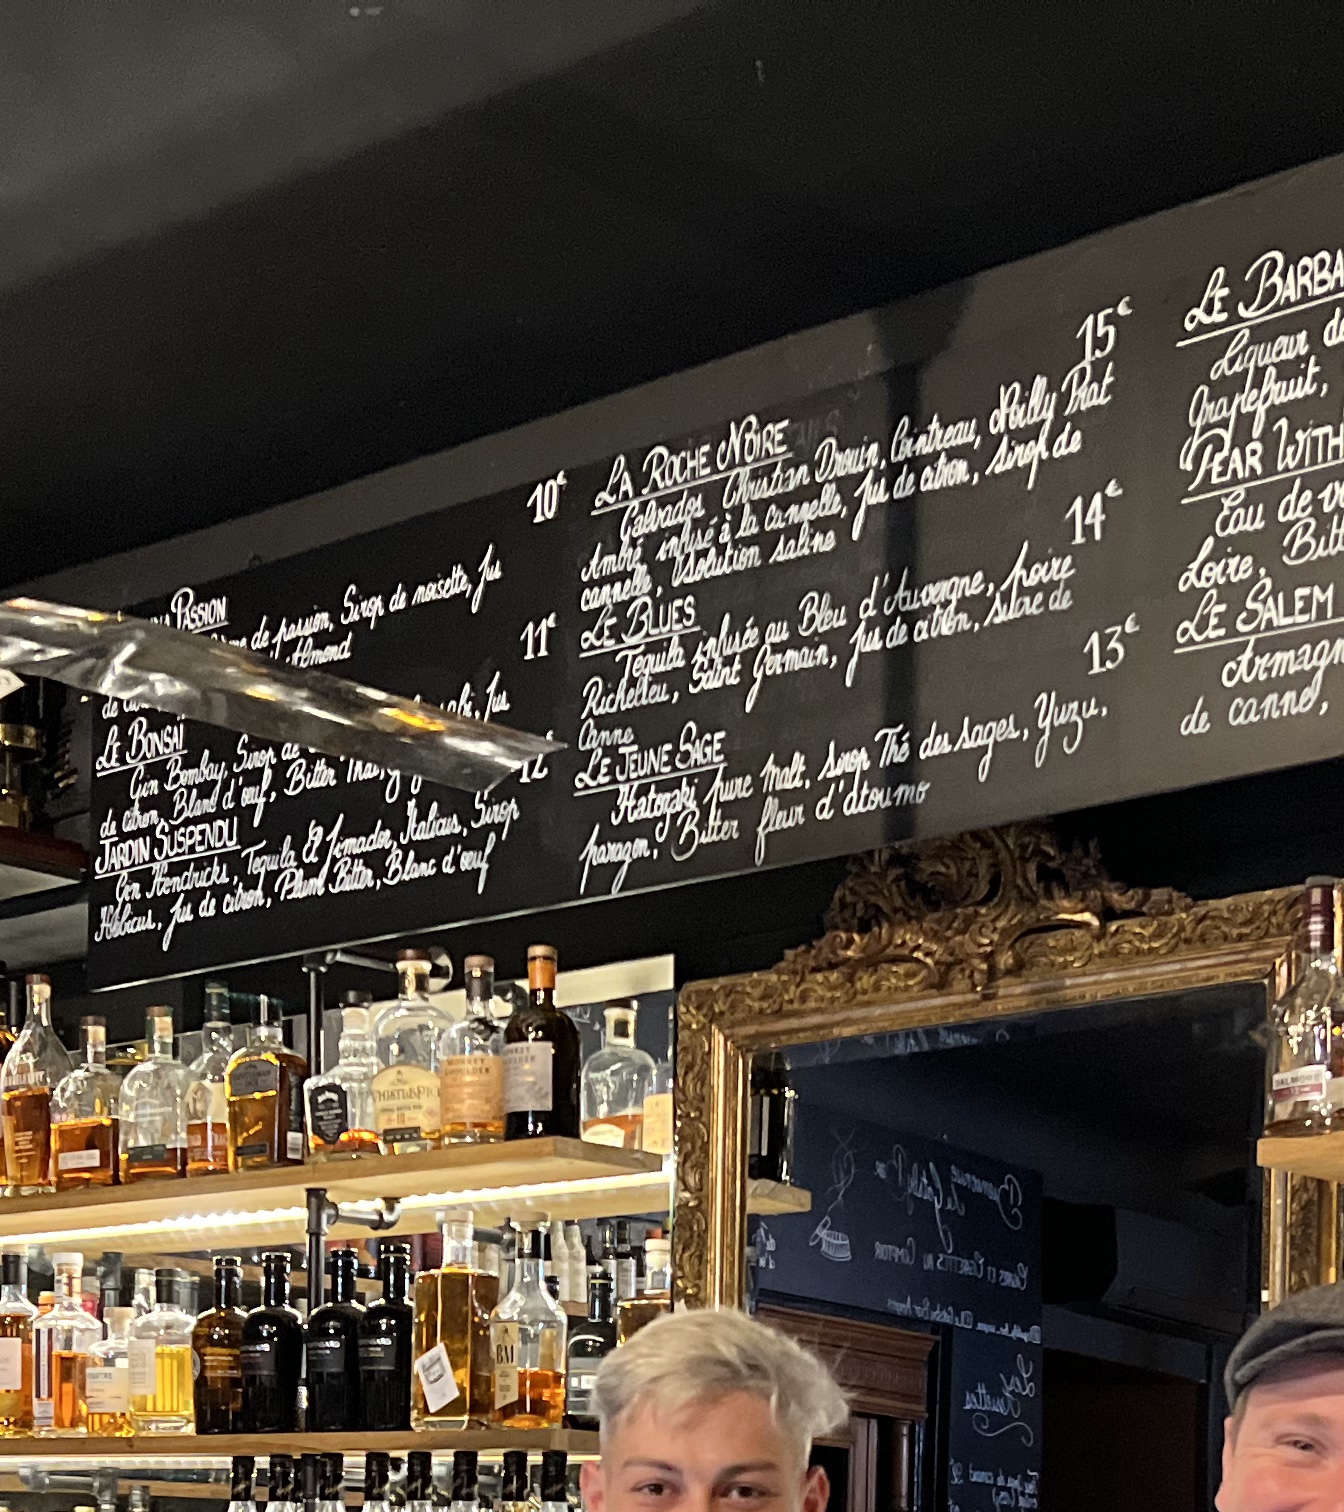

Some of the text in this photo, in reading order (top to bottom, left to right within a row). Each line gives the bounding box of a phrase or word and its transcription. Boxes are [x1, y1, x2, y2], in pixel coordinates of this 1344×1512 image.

[1210, 329, 1309, 385] Liqueur
[723, 464, 809, 509] Christian
[891, 413, 981, 463] Cointreau,
[989, 373, 1057, 452] Noilly
[1061, 361, 1115, 416] Prat
[1180, 356, 1328, 471] Grapefruit,
[642, 445, 711, 495] ROCHE
[716, 414, 790, 471] NOIRE
[1188, 428, 1263, 491] PEAR
[1215, 487, 1265, 538] Eau
[1278, 478, 1313, 523] de
[1178, 536, 1266, 592] Loire,
[171, 587, 226, 629] PASSION
[252, 616, 269, 650] de
[341, 584, 384, 629] Sirop
[390, 584, 406, 612] de
[621, 595, 696, 645] BLUES
[1236, 577, 1334, 632] SALEM
[874, 724, 910, 769] Thé
[920, 722, 953, 760] des
[1035, 692, 1108, 769] Yuzu,
[1180, 695, 1210, 736] de
[615, 744, 672, 782] JEUNE
[675, 720, 726, 770] SAGE
[95, 817, 238, 874] JARDIN SUSPENDU
[671, 808, 740, 861] Bitter
[755, 797, 806, 866] fleur
